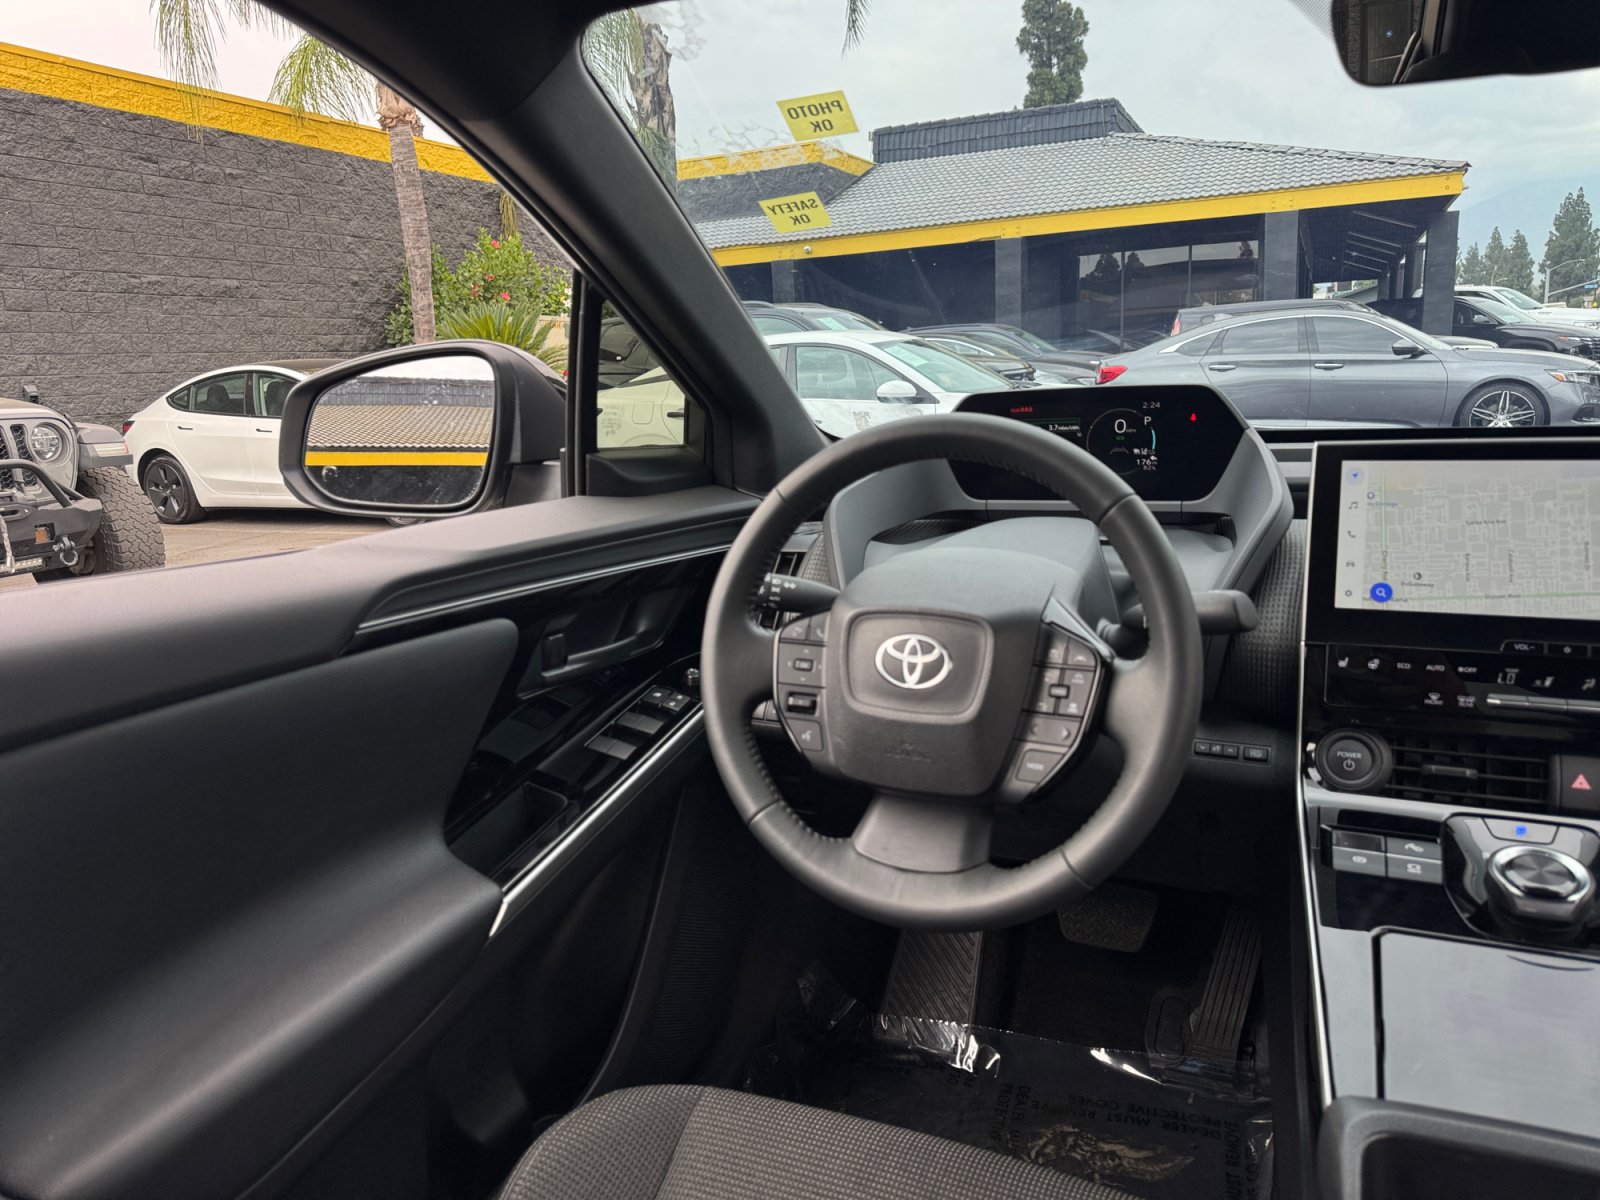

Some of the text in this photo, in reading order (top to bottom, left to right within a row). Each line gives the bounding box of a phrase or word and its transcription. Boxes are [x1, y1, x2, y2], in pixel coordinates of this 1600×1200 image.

[1142, 401, 1161, 409] 2:24
[1114, 419, 1127, 433] 0
[1143, 416, 1152, 426] P
[1425, 664, 1445, 672] AUTO
[1336, 750, 1362, 759] POWER
[1067, 1094, 1222, 1127] PROTECTIVE COVER
[1105, 1111, 1150, 1127] MUST
[1161, 1121, 1221, 1140] DEALER
